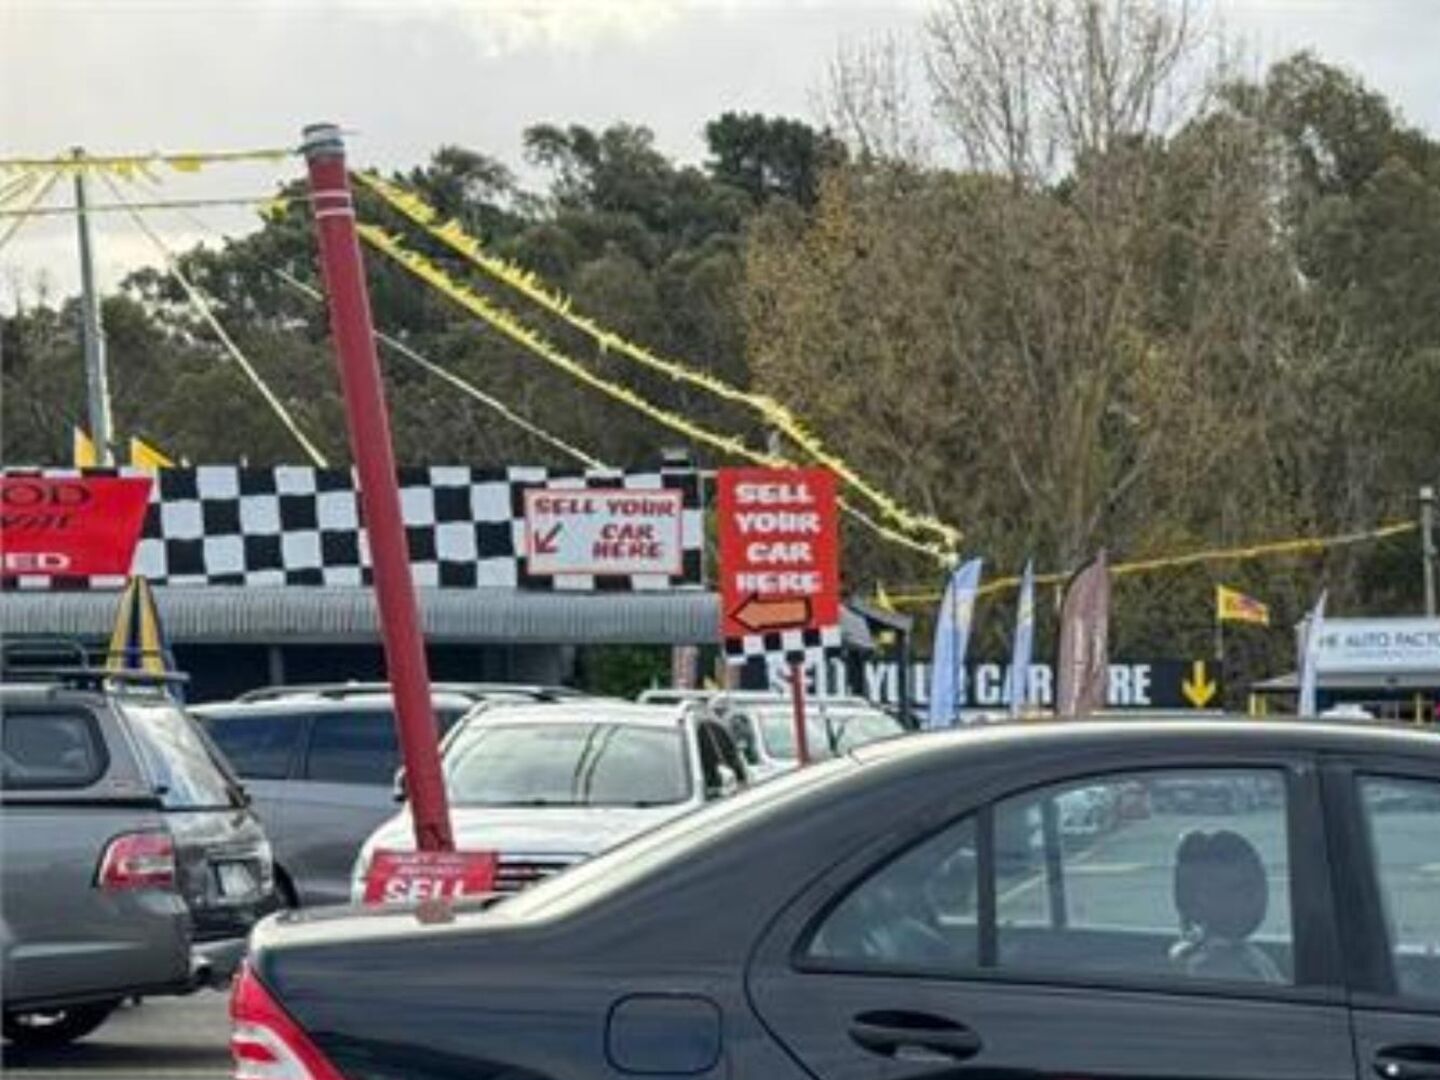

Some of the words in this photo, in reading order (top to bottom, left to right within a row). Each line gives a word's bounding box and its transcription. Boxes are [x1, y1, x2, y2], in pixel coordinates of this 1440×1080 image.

[735, 483, 815, 504] SELL
[534, 498, 597, 515] SELL
[606, 498, 676, 517] YOUR
[599, 523, 655, 541] CAR
[735, 512, 822, 535] YOUR
[592, 541, 661, 559] HERE
[746, 540, 813, 563] CAR
[735, 571, 823, 594] HERE
